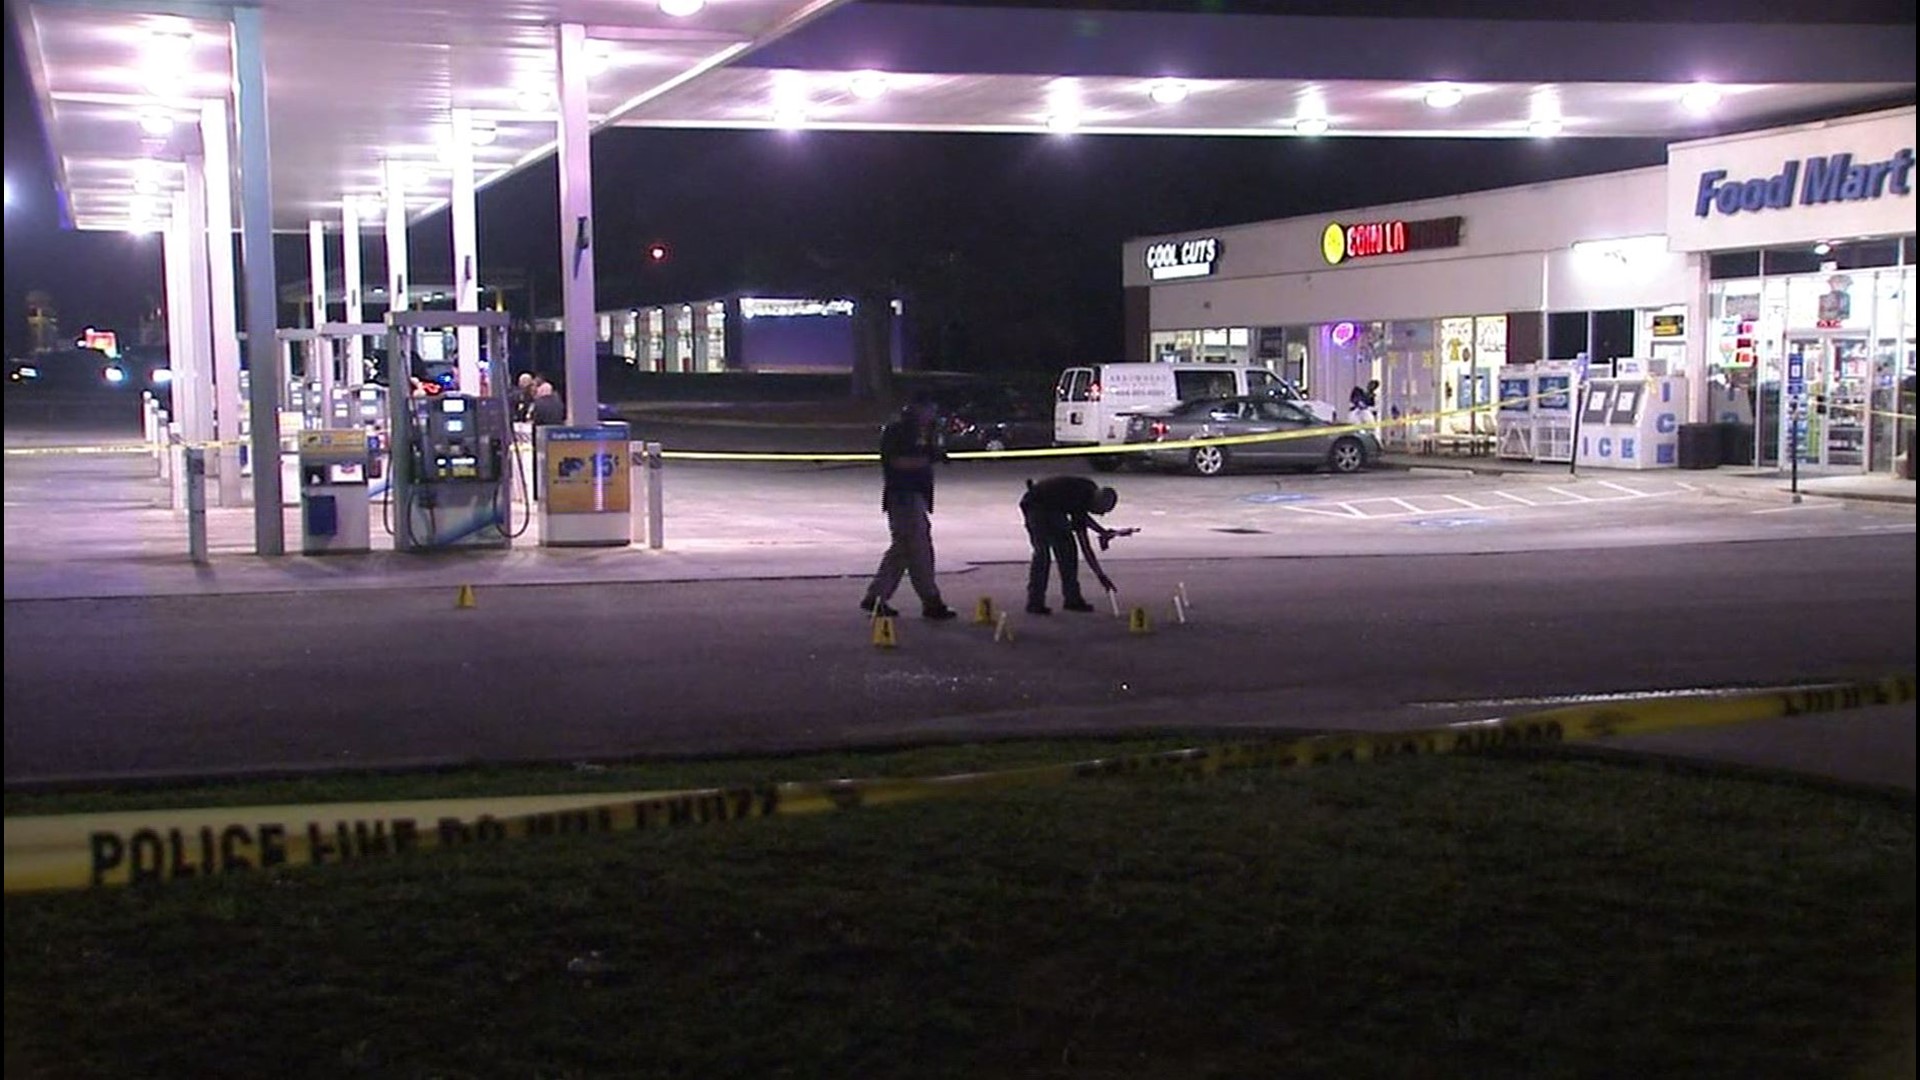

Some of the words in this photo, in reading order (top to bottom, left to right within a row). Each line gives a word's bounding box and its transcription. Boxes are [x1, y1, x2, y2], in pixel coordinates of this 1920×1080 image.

[1695, 160, 1799, 217] Food
[1800, 148, 1915, 205] Mart
[1147, 243, 1178, 269] COOL
[1181, 238, 1216, 265] CUTS
[1582, 436, 1635, 459] ICE
[90, 822, 286, 886] POLICE
